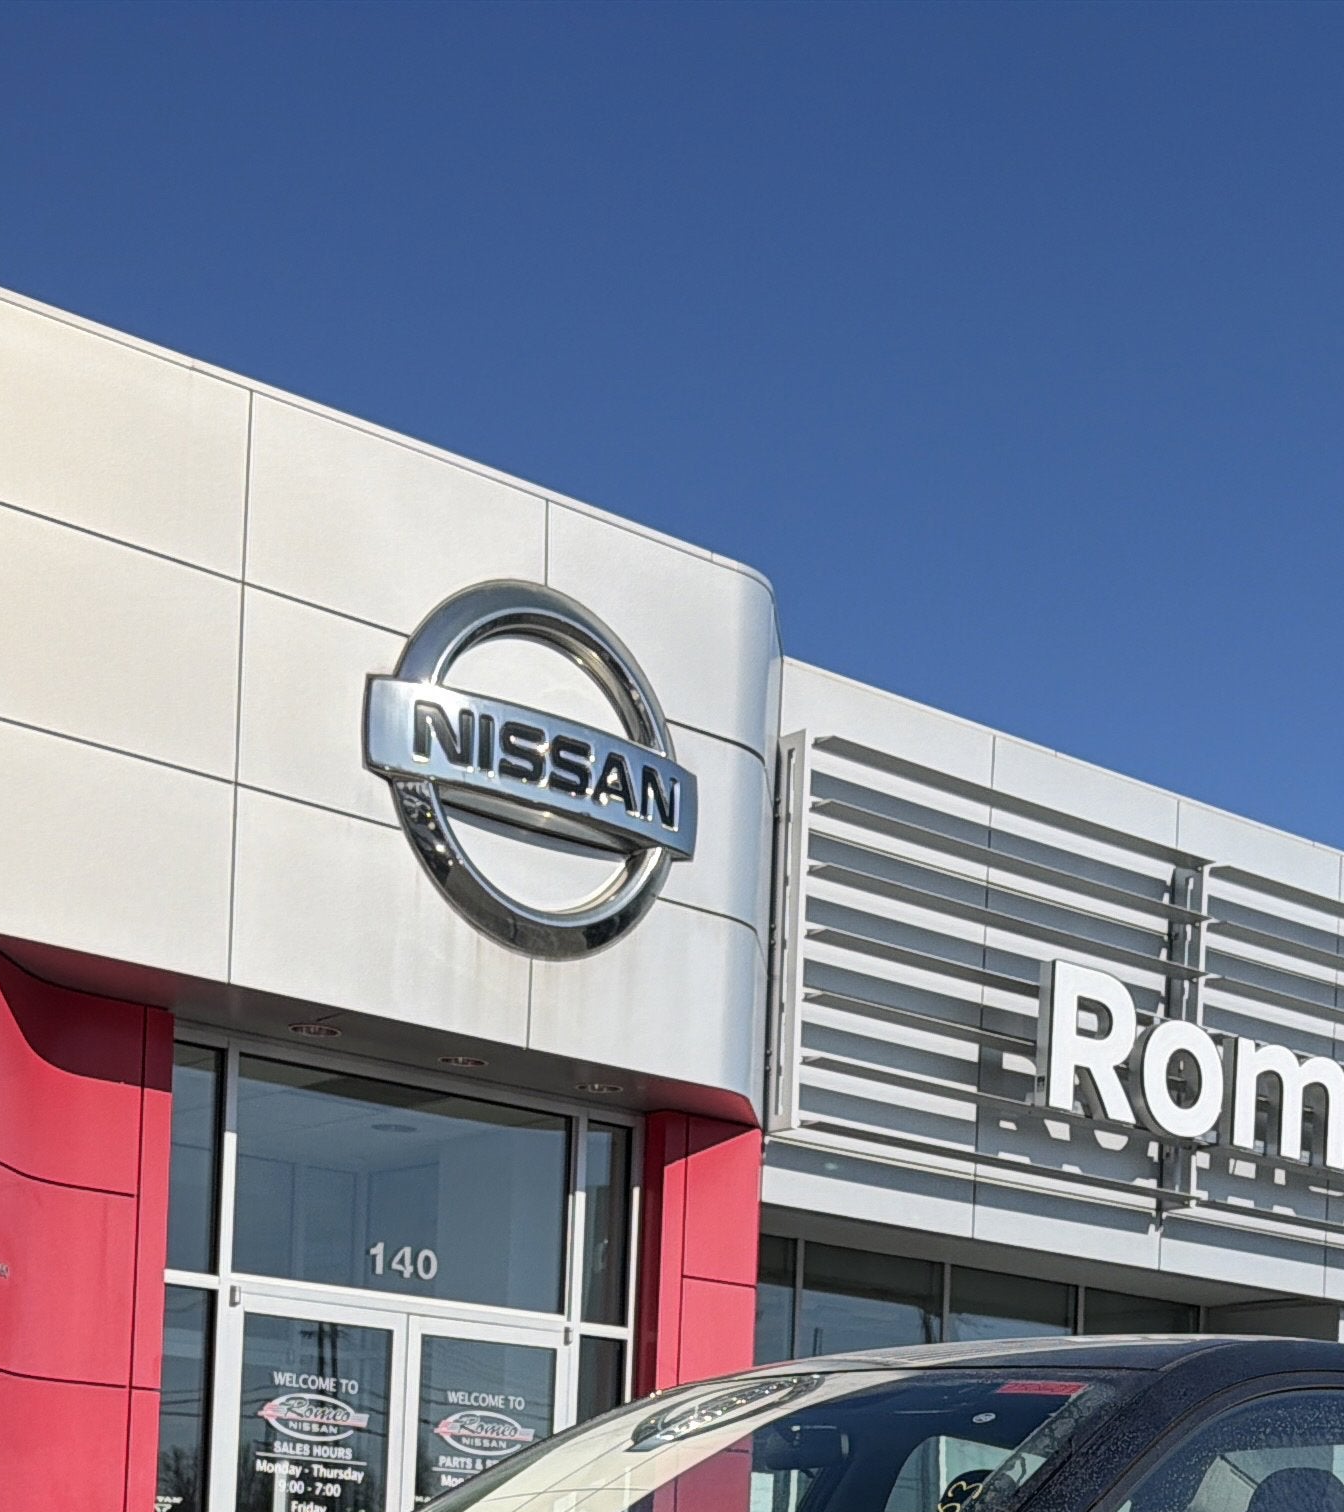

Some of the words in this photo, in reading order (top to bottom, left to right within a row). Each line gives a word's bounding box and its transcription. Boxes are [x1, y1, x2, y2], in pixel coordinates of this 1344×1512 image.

[412, 699, 681, 833] NISSAN
[368, 1241, 439, 1282] 140
[273, 1371, 337, 1392] WELCOME
[340, 1379, 359, 1395] TO
[279, 1397, 351, 1422] Romeo
[447, 1391, 505, 1409] WELCOME
[507, 1396, 525, 1411] TO
[289, 1421, 338, 1434] NISSAN
[458, 1413, 518, 1437] Romeo
[273, 1441, 310, 1456] SALES
[313, 1446, 353, 1460] HOURS
[462, 1437, 507, 1449] NISSAN
[256, 1459, 302, 1478] Monday
[312, 1464, 364, 1484] Thursday
[439, 1455, 473, 1469] PARTS
[475, 1459, 484, 1470] &
[278, 1480, 305, 1494] 9:00
[315, 1482, 341, 1497] 7:00
